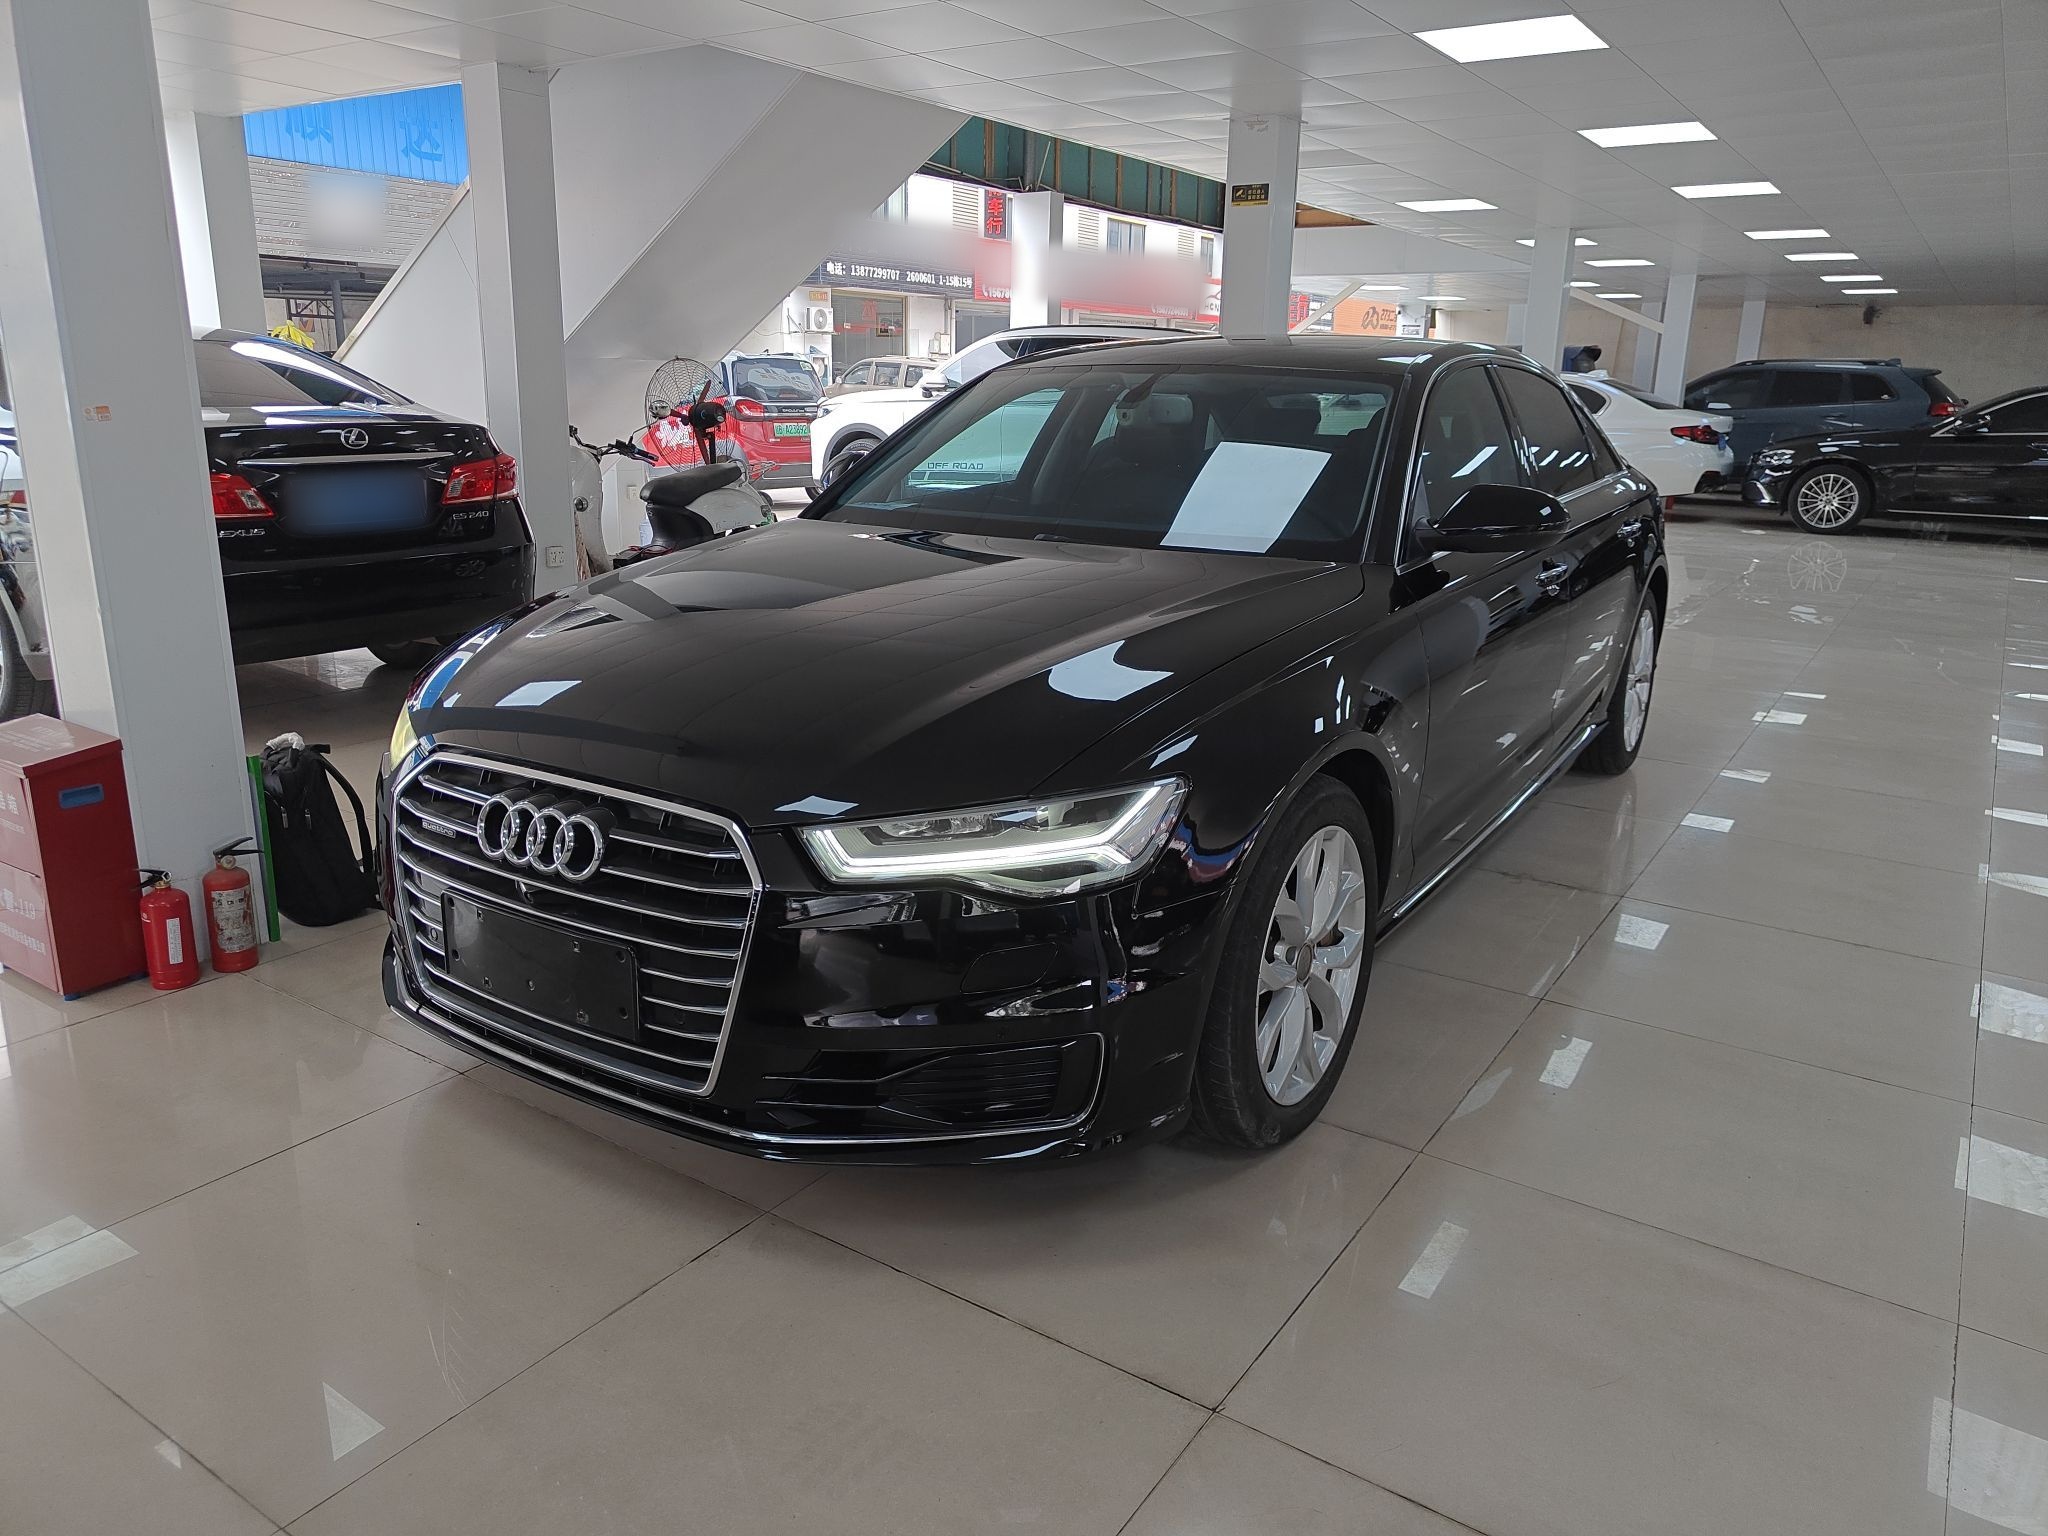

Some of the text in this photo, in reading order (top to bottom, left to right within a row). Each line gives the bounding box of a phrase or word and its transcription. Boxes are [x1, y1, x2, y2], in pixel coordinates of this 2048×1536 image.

[850, 264, 901, 281] 13877299707
[906, 270, 936, 284] 2600601
[927, 462, 984, 470] OFF ROAD
[452, 510, 489, 520] ES 240
[217, 528, 266, 538] EXUS
[422, 820, 455, 837] quattro
